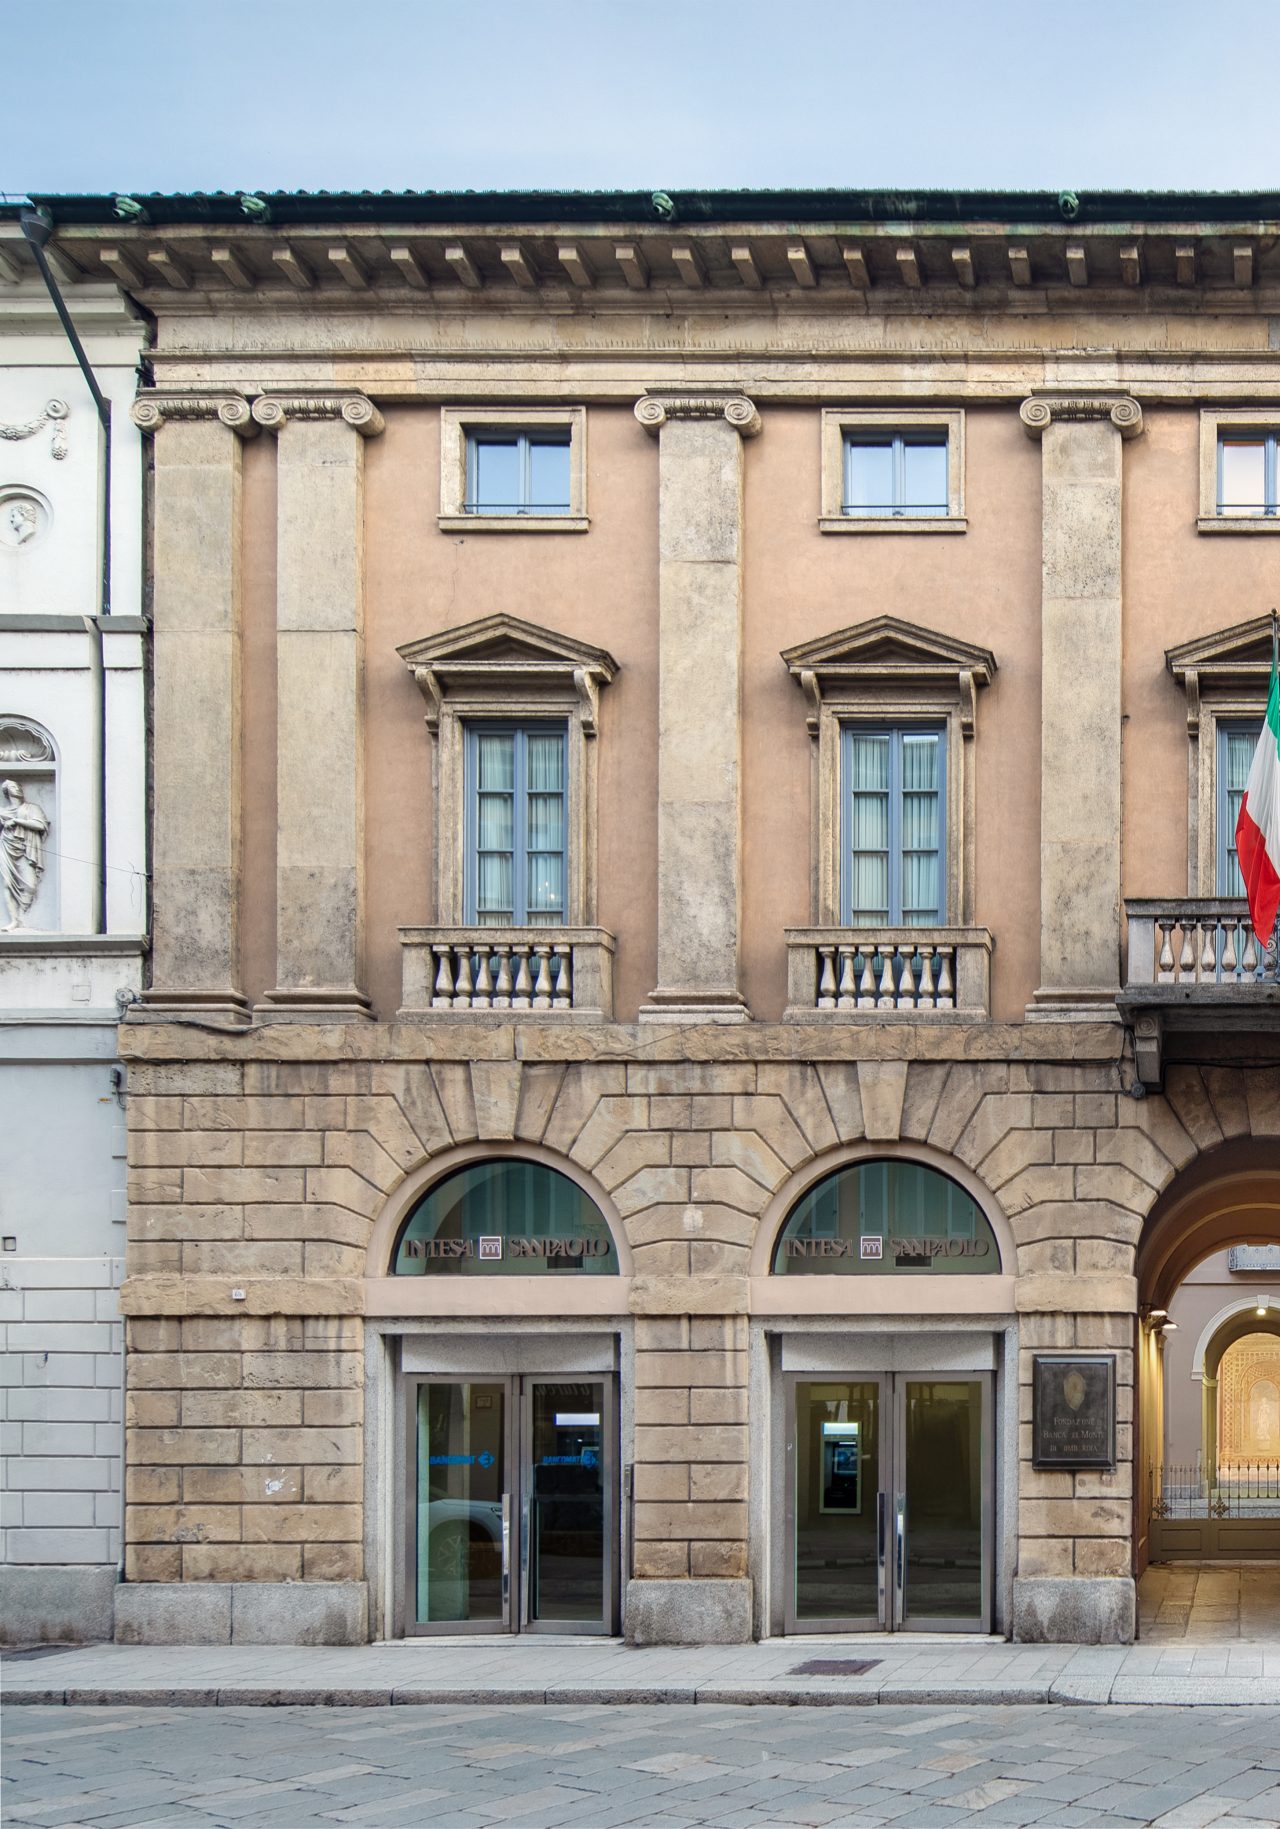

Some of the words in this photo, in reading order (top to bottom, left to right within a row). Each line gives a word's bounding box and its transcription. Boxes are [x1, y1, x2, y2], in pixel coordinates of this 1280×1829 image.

[404, 1238, 474, 1258] INTESA
[508, 1238, 610, 1258] SANPAOLO
[784, 1238, 854, 1258] INTESA
[888, 1237, 990, 1258] SANPAOLO
